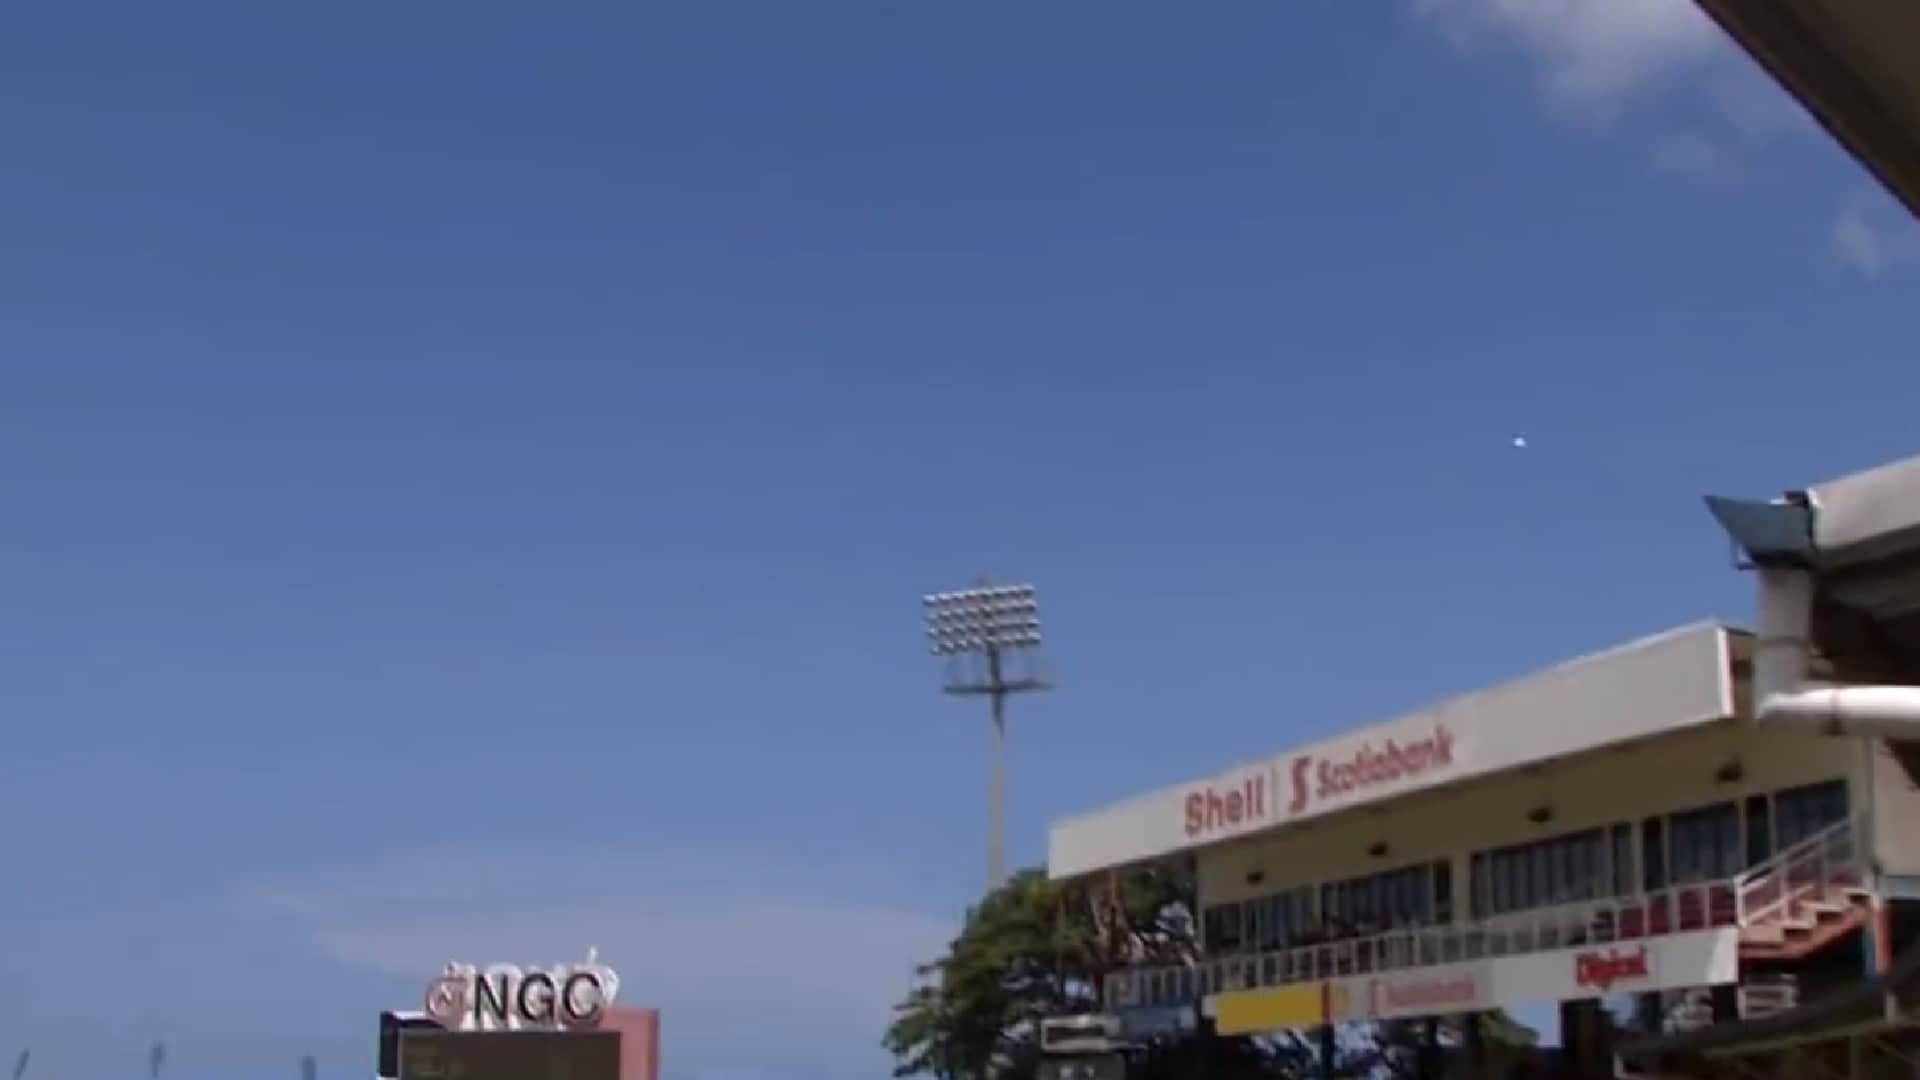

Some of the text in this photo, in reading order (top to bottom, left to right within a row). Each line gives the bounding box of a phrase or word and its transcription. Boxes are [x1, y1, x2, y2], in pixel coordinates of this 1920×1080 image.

[1316, 724, 1454, 799] Scotiabank
[1185, 774, 1264, 835] Shell
[473, 971, 603, 1022] NGC
